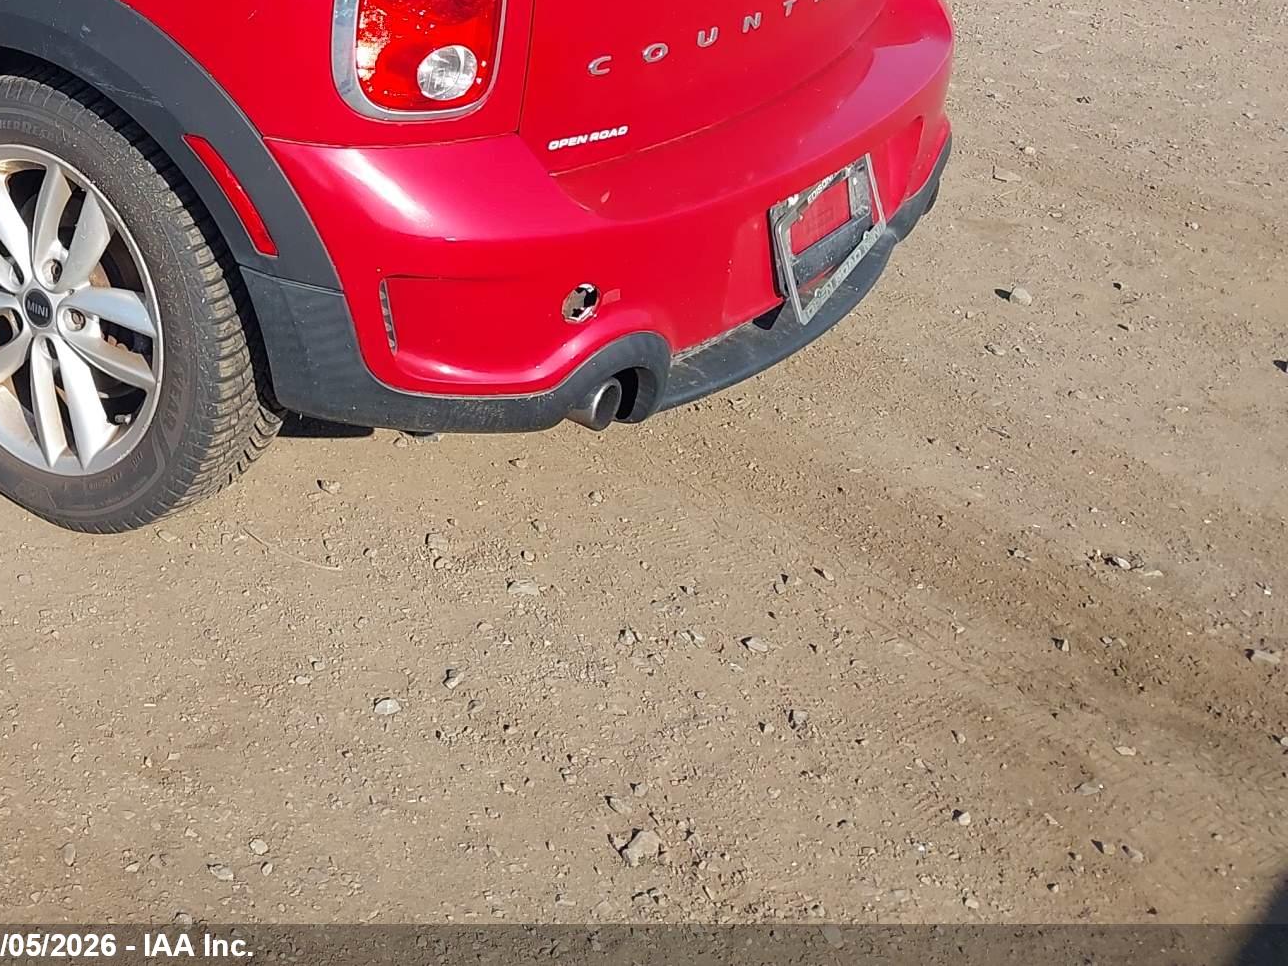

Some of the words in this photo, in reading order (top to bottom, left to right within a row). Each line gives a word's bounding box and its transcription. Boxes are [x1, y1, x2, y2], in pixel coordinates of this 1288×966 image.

[548, 134, 588, 151] OPEN
[589, 125, 629, 142] ROAD
[836, 248, 864, 286] ROAD
[26, 299, 50, 319] MINI
